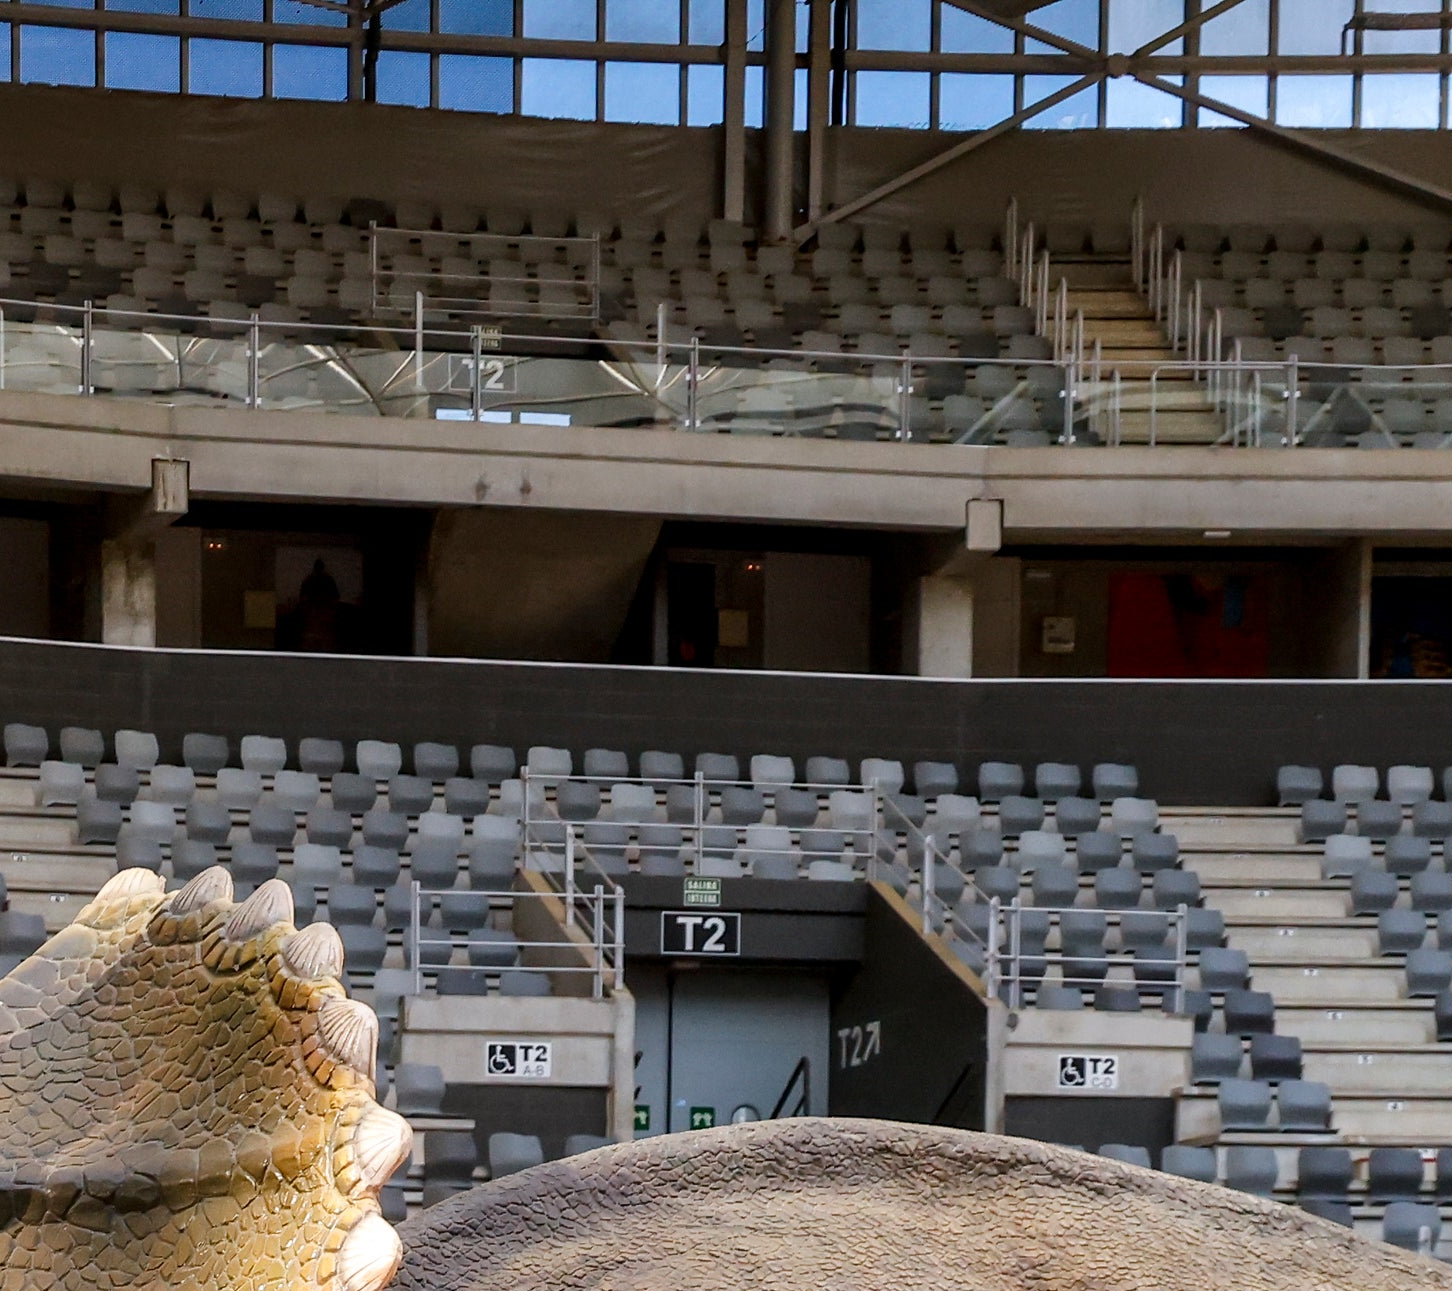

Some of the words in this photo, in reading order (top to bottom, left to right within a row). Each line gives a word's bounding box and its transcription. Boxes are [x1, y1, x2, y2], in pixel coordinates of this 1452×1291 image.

[676, 916, 726, 952] T2
[519, 1045, 548, 1062] T2
[838, 1026, 863, 1069] T2
[1088, 1058, 1115, 1074] T2
